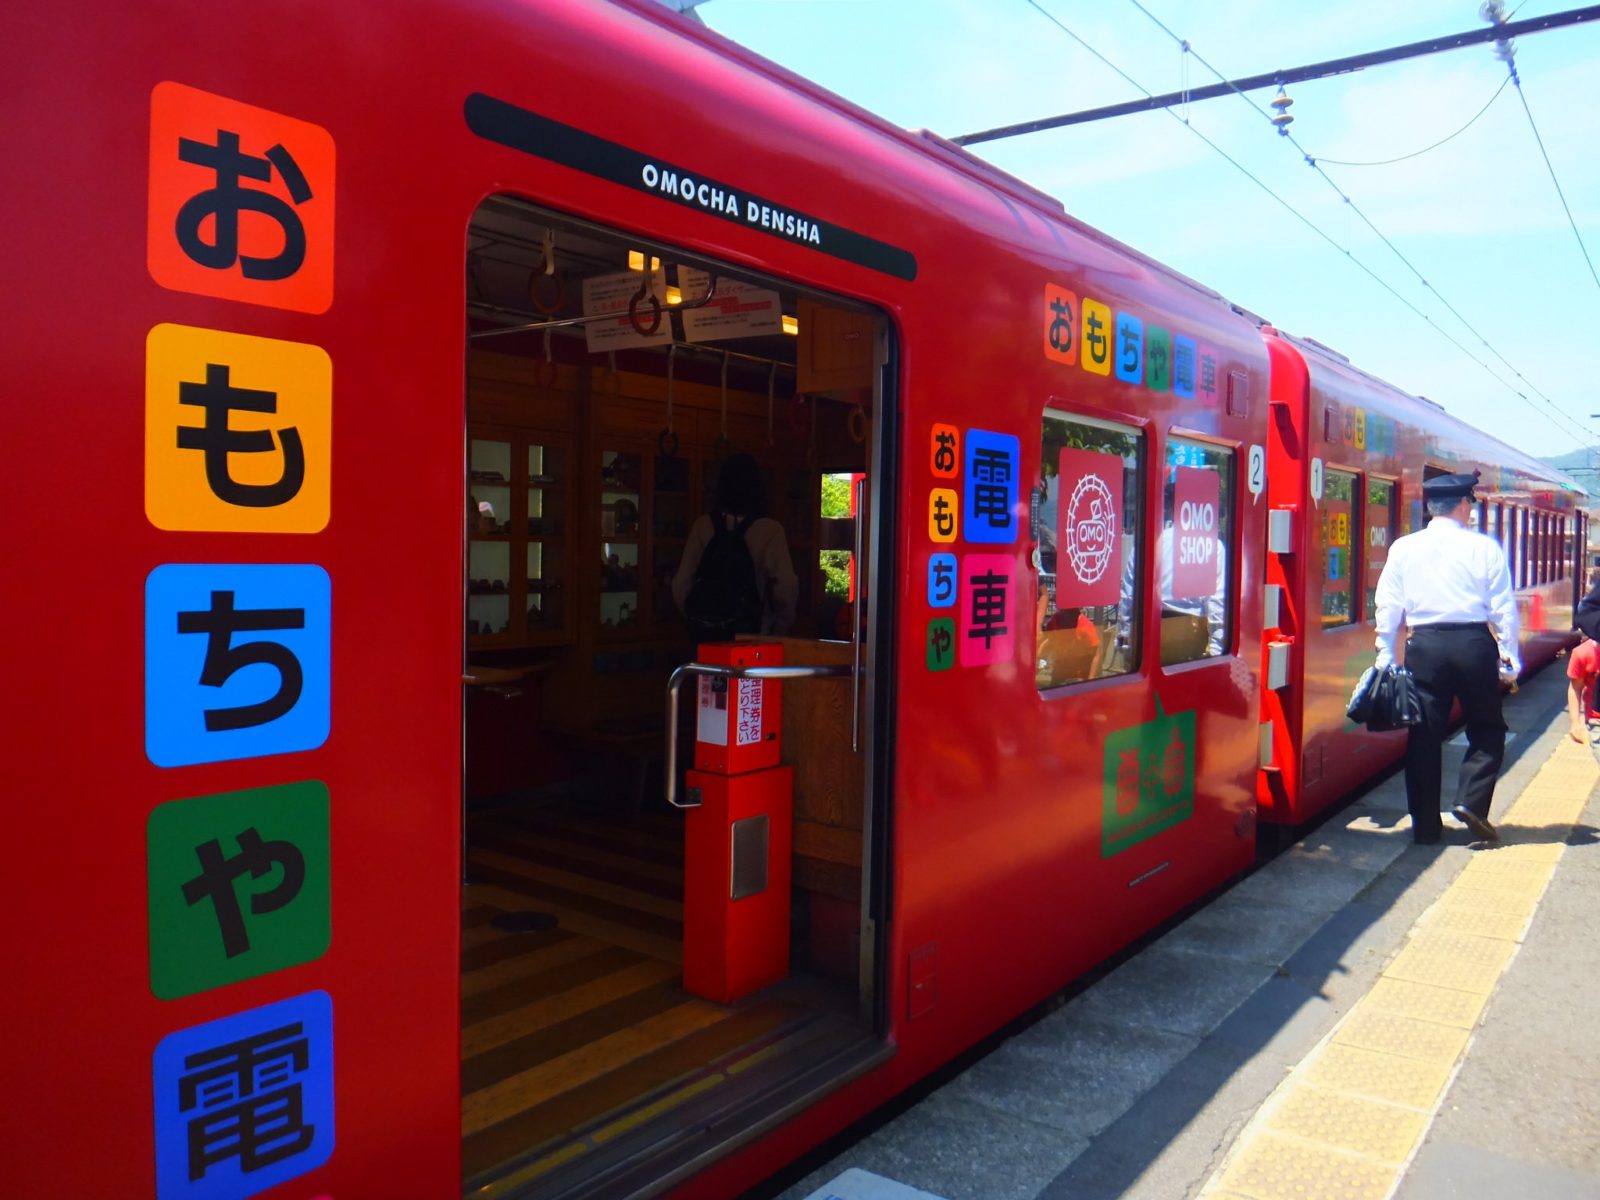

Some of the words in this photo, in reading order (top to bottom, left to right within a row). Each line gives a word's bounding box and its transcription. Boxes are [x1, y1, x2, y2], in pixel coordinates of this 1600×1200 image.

[642, 164, 739, 216] OMOCHA
[747, 201, 821, 244] DENSHA
[1250, 453, 1261, 486] 2
[1180, 501, 1214, 532] OMO
[967, 447, 1012, 650] 電車
[1079, 524, 1104, 543] OMO
[1179, 536, 1213, 565] SHOP
